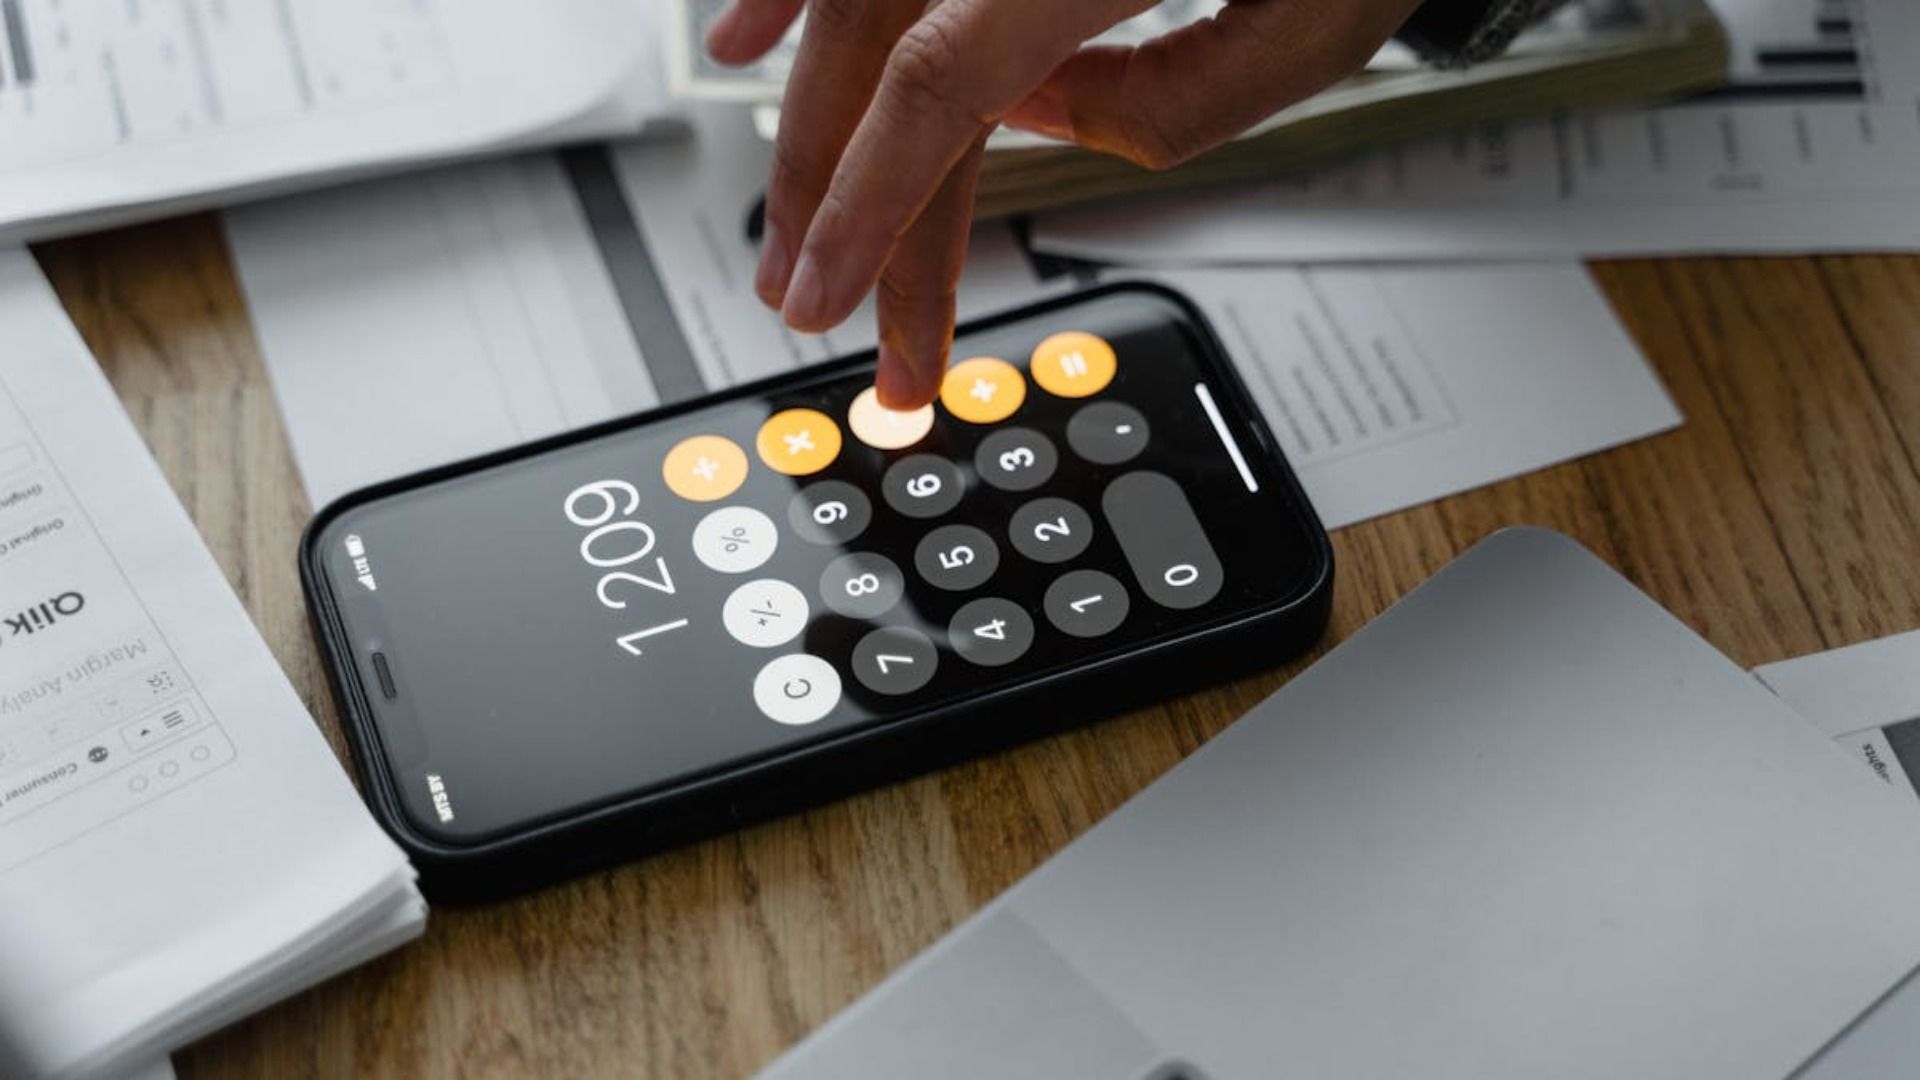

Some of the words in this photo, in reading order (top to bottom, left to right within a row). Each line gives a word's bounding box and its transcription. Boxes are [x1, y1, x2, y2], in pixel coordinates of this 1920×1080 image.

[1000, 447, 1035, 472] 3
[906, 473, 942, 498] 6
[813, 501, 848, 525] 9
[1034, 516, 1071, 542] 2
[938, 545, 975, 569] 5
[845, 573, 880, 597] 8
[1164, 564, 1199, 588] 0
[3, 591, 85, 636] Qlik
[1070, 594, 1102, 614] 1
[973, 618, 1006, 641] 4
[66, 637, 148, 679] Margin
[876, 653, 914, 675] 7
[784, 678, 812, 700] C
[4, 761, 78, 802] Consumer
